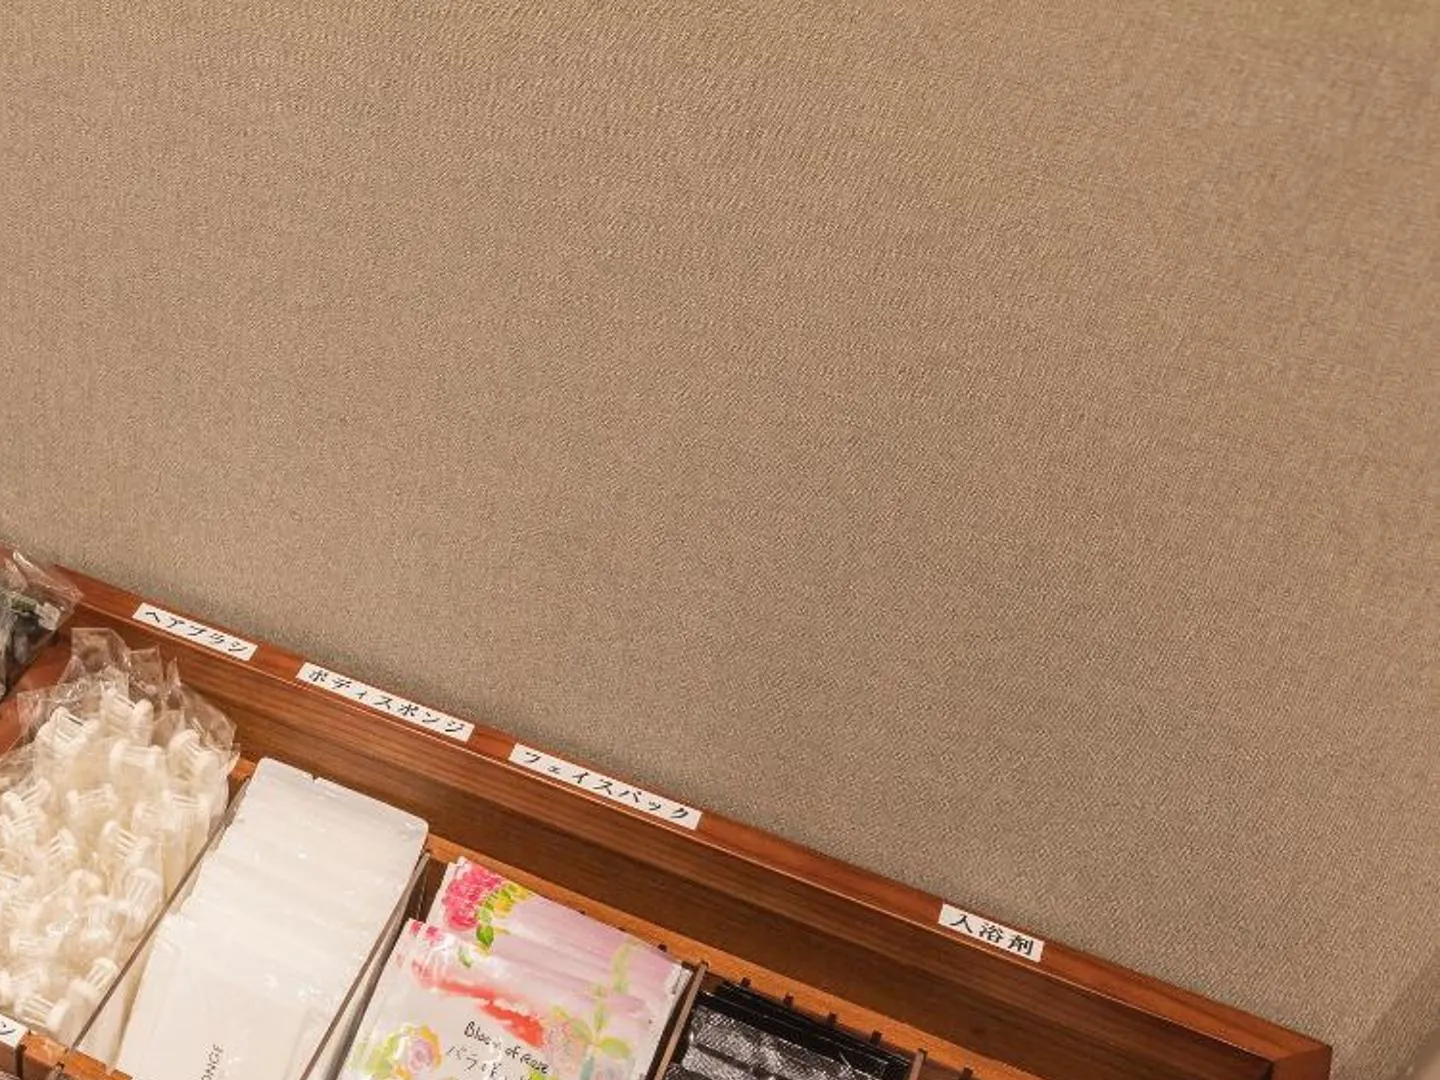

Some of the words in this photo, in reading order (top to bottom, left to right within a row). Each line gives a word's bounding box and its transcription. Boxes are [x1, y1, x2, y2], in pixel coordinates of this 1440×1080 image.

[309, 668, 464, 733] ボディスポンジ
[950, 914, 1034, 957] 入浴剤
